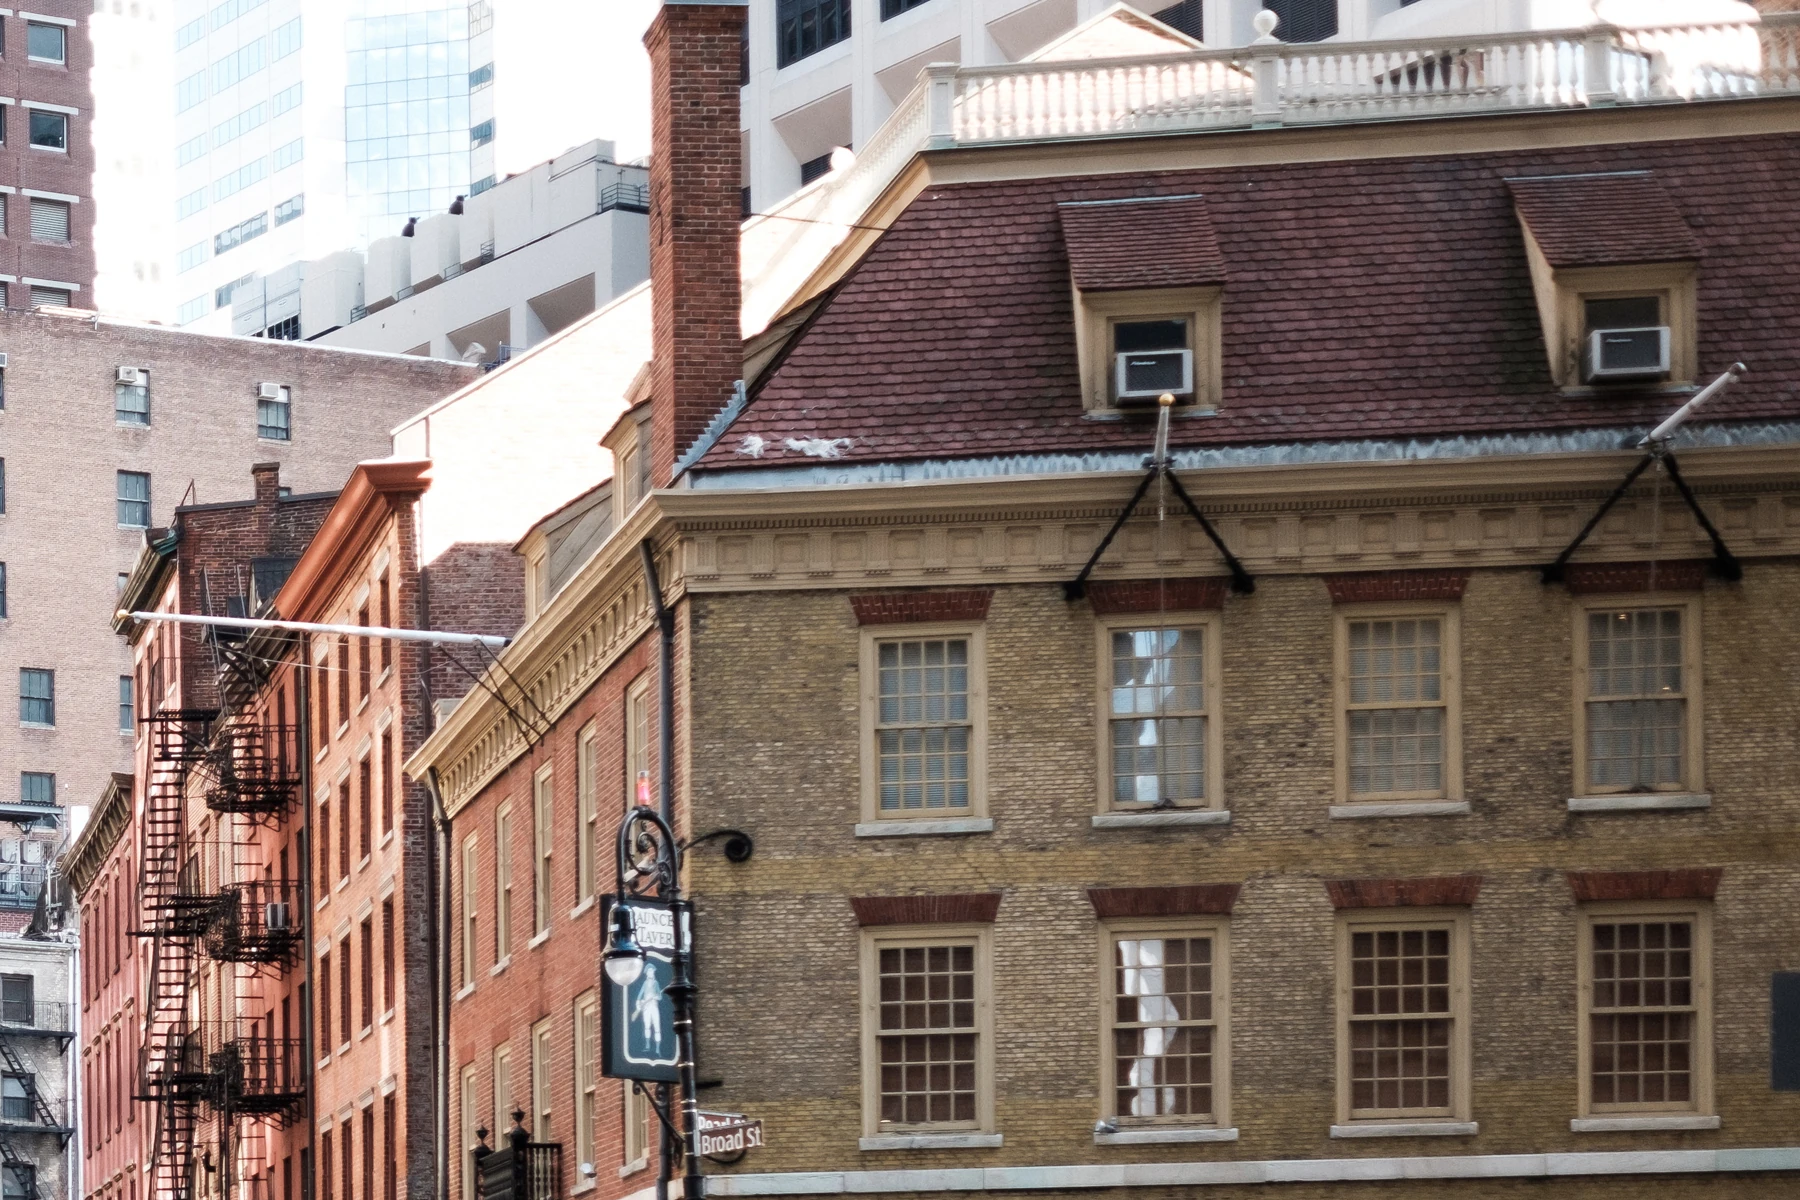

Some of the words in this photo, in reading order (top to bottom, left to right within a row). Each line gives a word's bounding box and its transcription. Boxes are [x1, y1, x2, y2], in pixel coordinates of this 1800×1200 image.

[636, 926, 675, 947] TAVER
[702, 1128, 744, 1155] Broad
[746, 1126, 761, 1148] St
